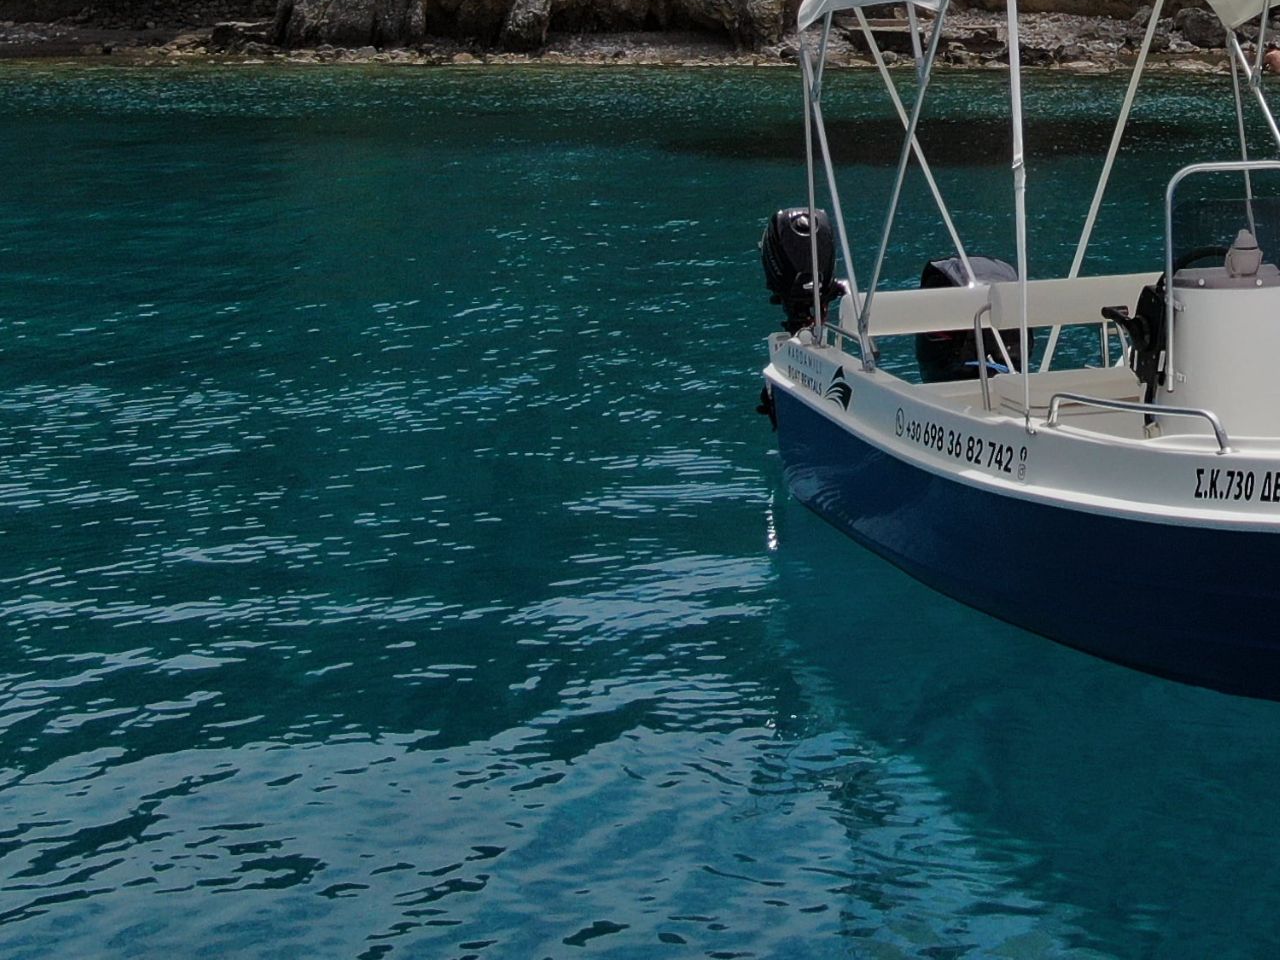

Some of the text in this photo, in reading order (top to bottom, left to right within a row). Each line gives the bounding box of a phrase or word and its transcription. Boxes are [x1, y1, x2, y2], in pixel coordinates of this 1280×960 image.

[906, 420, 1014, 473] +30 698 36 82 742
[1194, 468, 1255, 501] Σ.Κ.730
